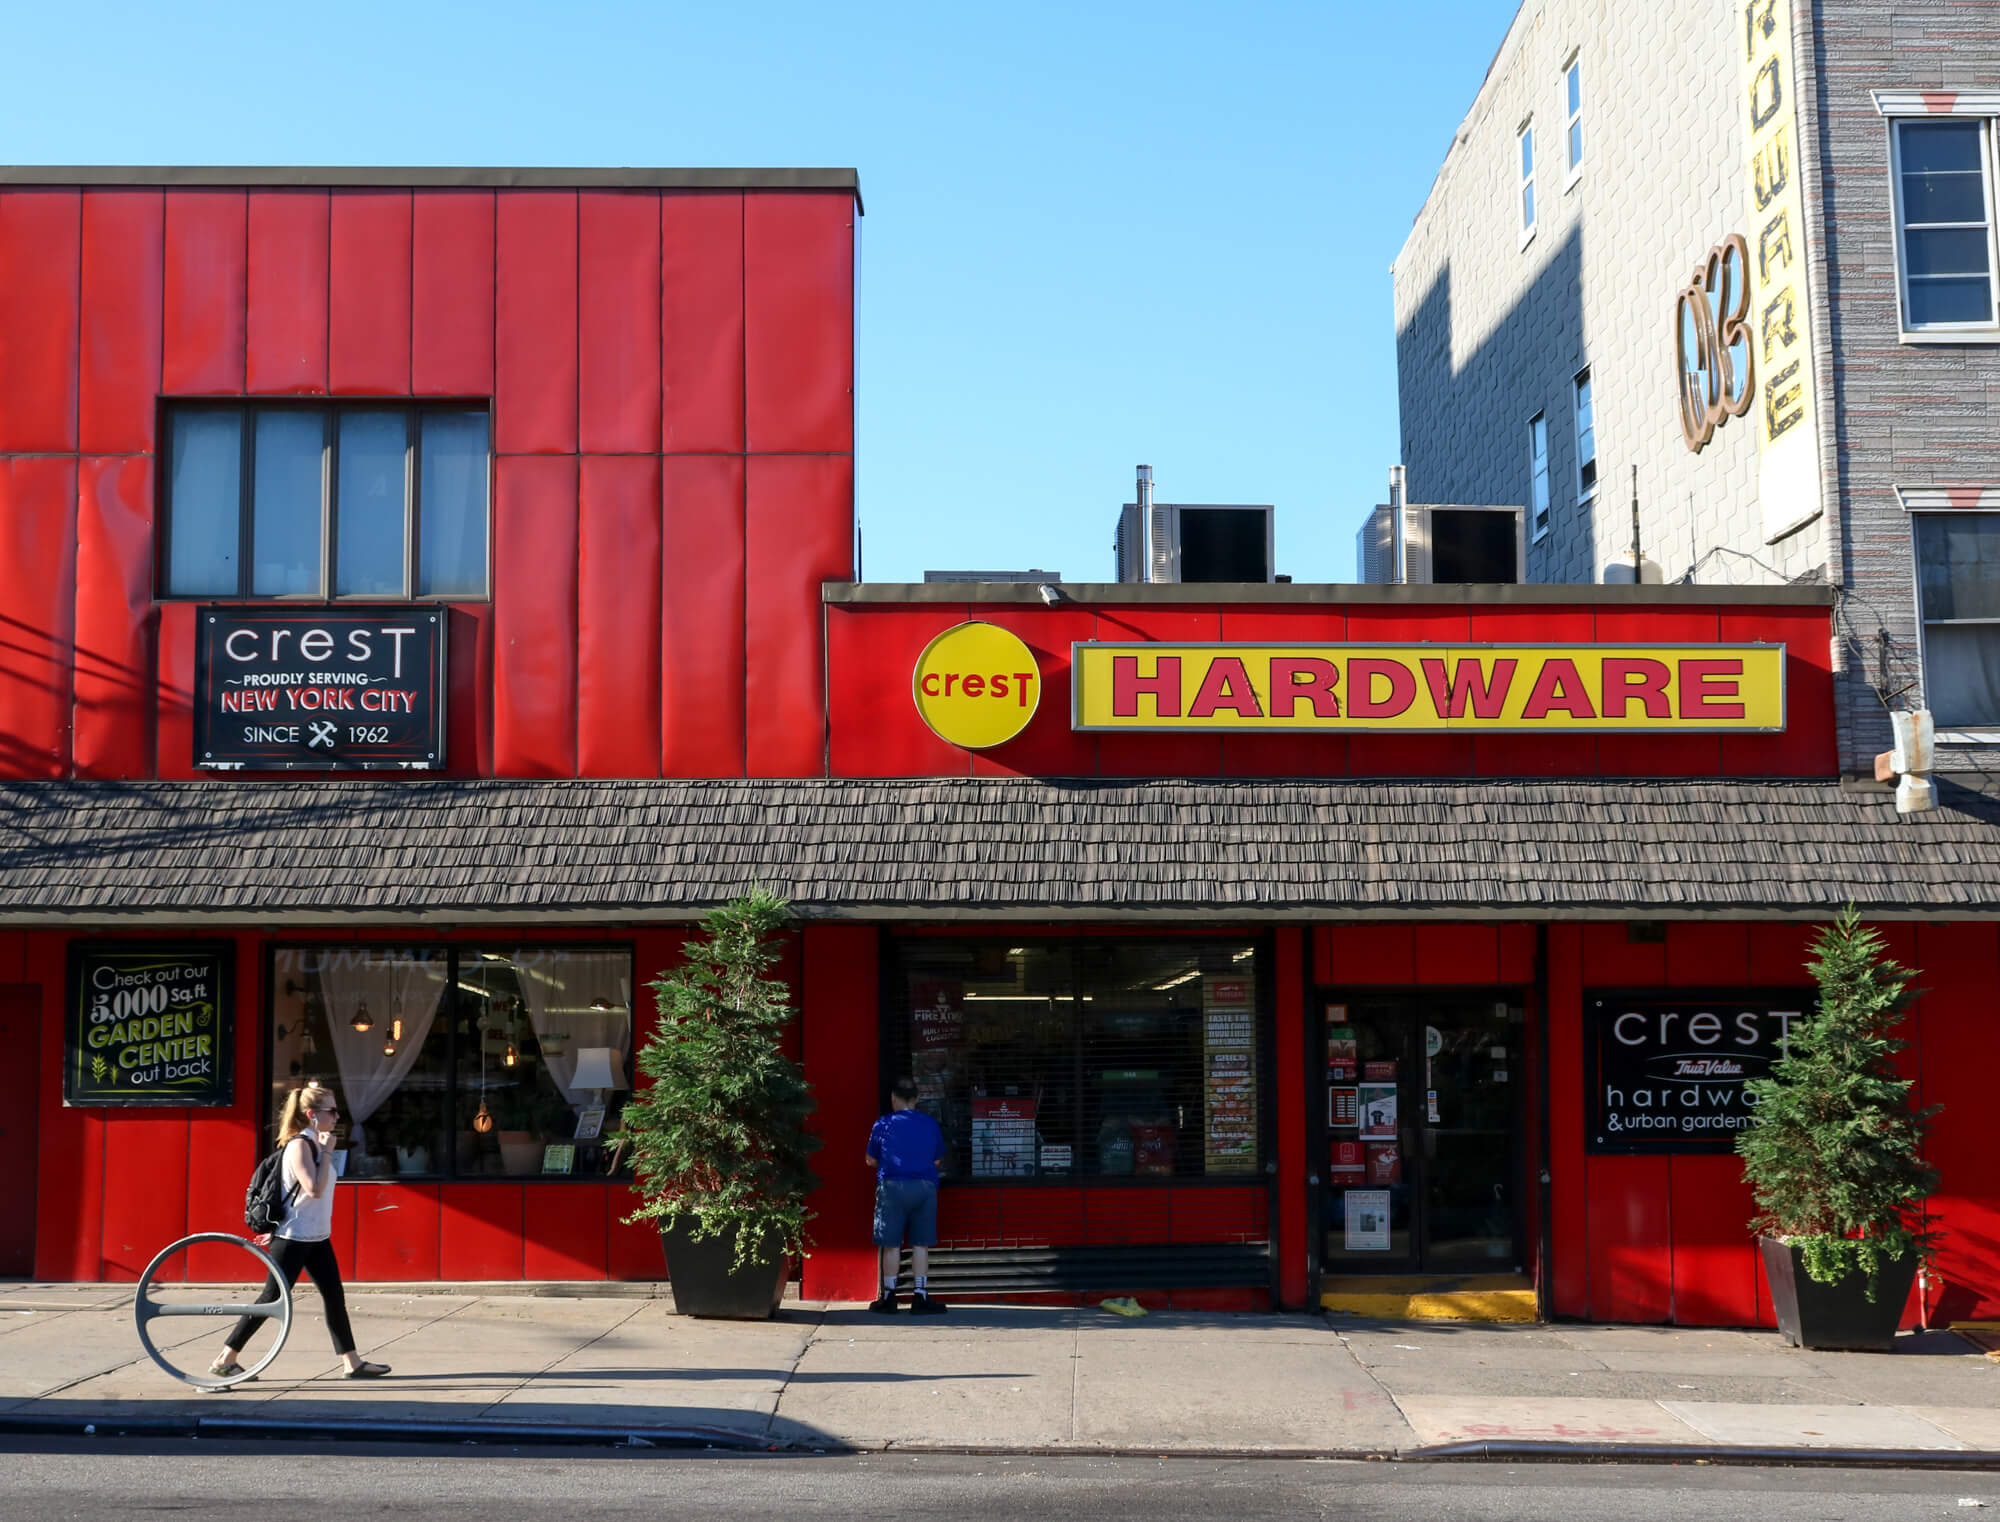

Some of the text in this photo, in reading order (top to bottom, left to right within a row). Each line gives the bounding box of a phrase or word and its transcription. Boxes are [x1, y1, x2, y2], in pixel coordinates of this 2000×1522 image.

[243, 672, 369, 686] PROUDLY SERVING
[1111, 656, 1746, 721] HARDWARE
[221, 687, 417, 713] NEW YORK CITY
[243, 727, 389, 743] SINCE 1962
[93, 966, 209, 990] Check out our
[90, 984, 168, 1024] 5,000
[88, 1011, 193, 1048] GARDEN
[118, 1034, 212, 1069] CENTER
[131, 1058, 211, 1084] out back
[1607, 1085, 1759, 1107] hardwa
[1682, 1113, 1748, 1132] garden
